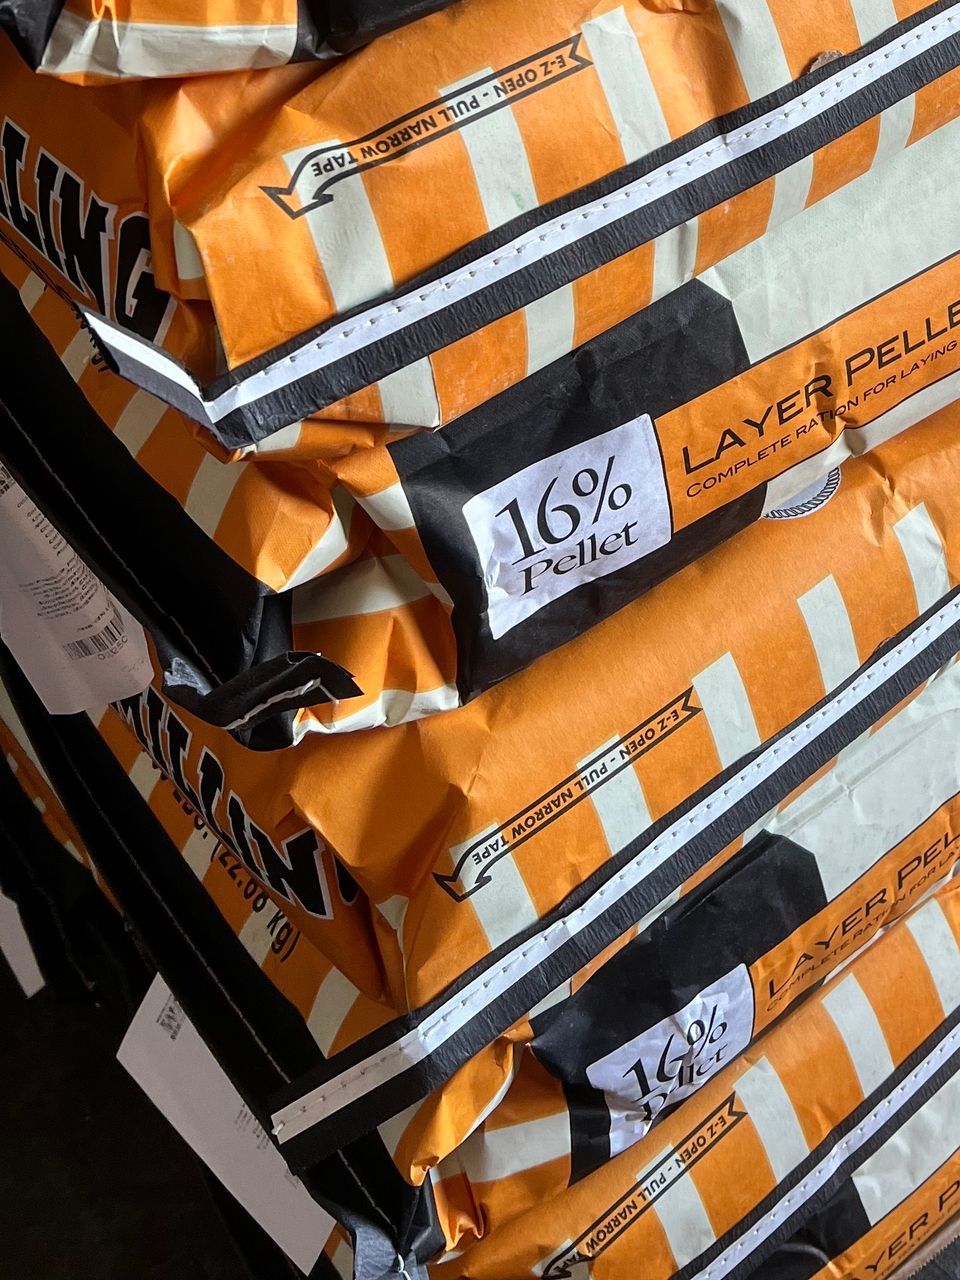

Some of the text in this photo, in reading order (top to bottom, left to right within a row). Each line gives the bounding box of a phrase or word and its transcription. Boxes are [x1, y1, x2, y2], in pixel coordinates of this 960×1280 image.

[543, 55, 567, 77] E-Z
[496, 69, 538, 98] OPEN
[437, 98, 481, 123] PULL
[360, 115, 438, 160] NARROW
[311, 151, 358, 177] TAPE
[0, 115, 177, 347] LING
[681, 372, 833, 476] LAYER
[685, 432, 793, 499] COMPLETE
[795, 401, 860, 440] RATION
[862, 379, 898, 404] FOR
[900, 340, 959, 381] LAYING
[494, 455, 634, 567] 16%
[519, 520, 640, 596] Pellet
[658, 708, 680, 732] E-Z
[620, 729, 656, 759] OPEN
[576, 763, 609, 793] PULL
[512, 788, 574, 839] NARROW
[471, 835, 509, 866] TAPE
[766, 940, 850, 1012] COMPLETE
[853, 893, 907, 939] RATIN
[909, 867, 937, 895] FOR
[768, 887, 888, 1000] LAYER
[707, 1116, 727, 1137] E-Z
[676, 1136, 707, 1169] OPEN
[638, 1174, 667, 1202] PULL
[585, 1200, 638, 1252] NARROW
